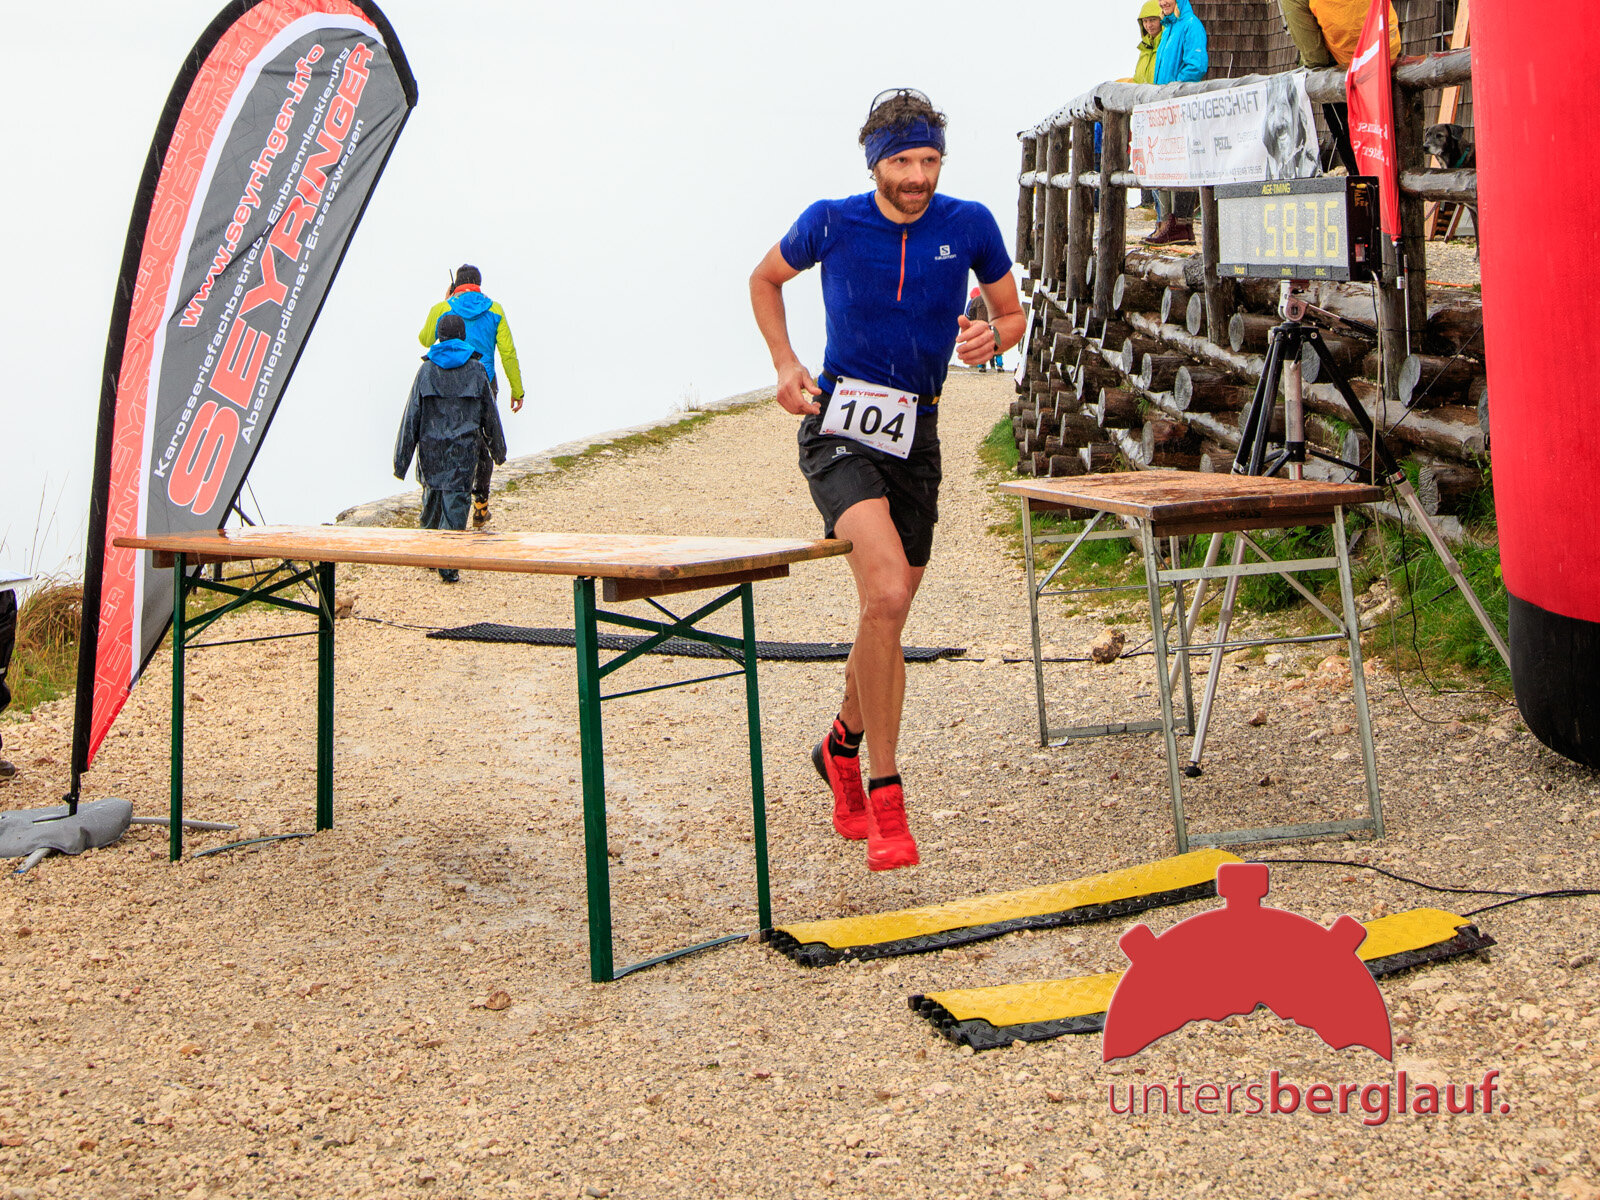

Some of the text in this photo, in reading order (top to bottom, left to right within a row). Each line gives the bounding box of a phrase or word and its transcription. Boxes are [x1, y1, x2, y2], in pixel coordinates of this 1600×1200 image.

[167, 42, 375, 516] SEYRINGER
[178, 43, 326, 328] www.seyringer.info
[840, 399, 905, 443] 104
